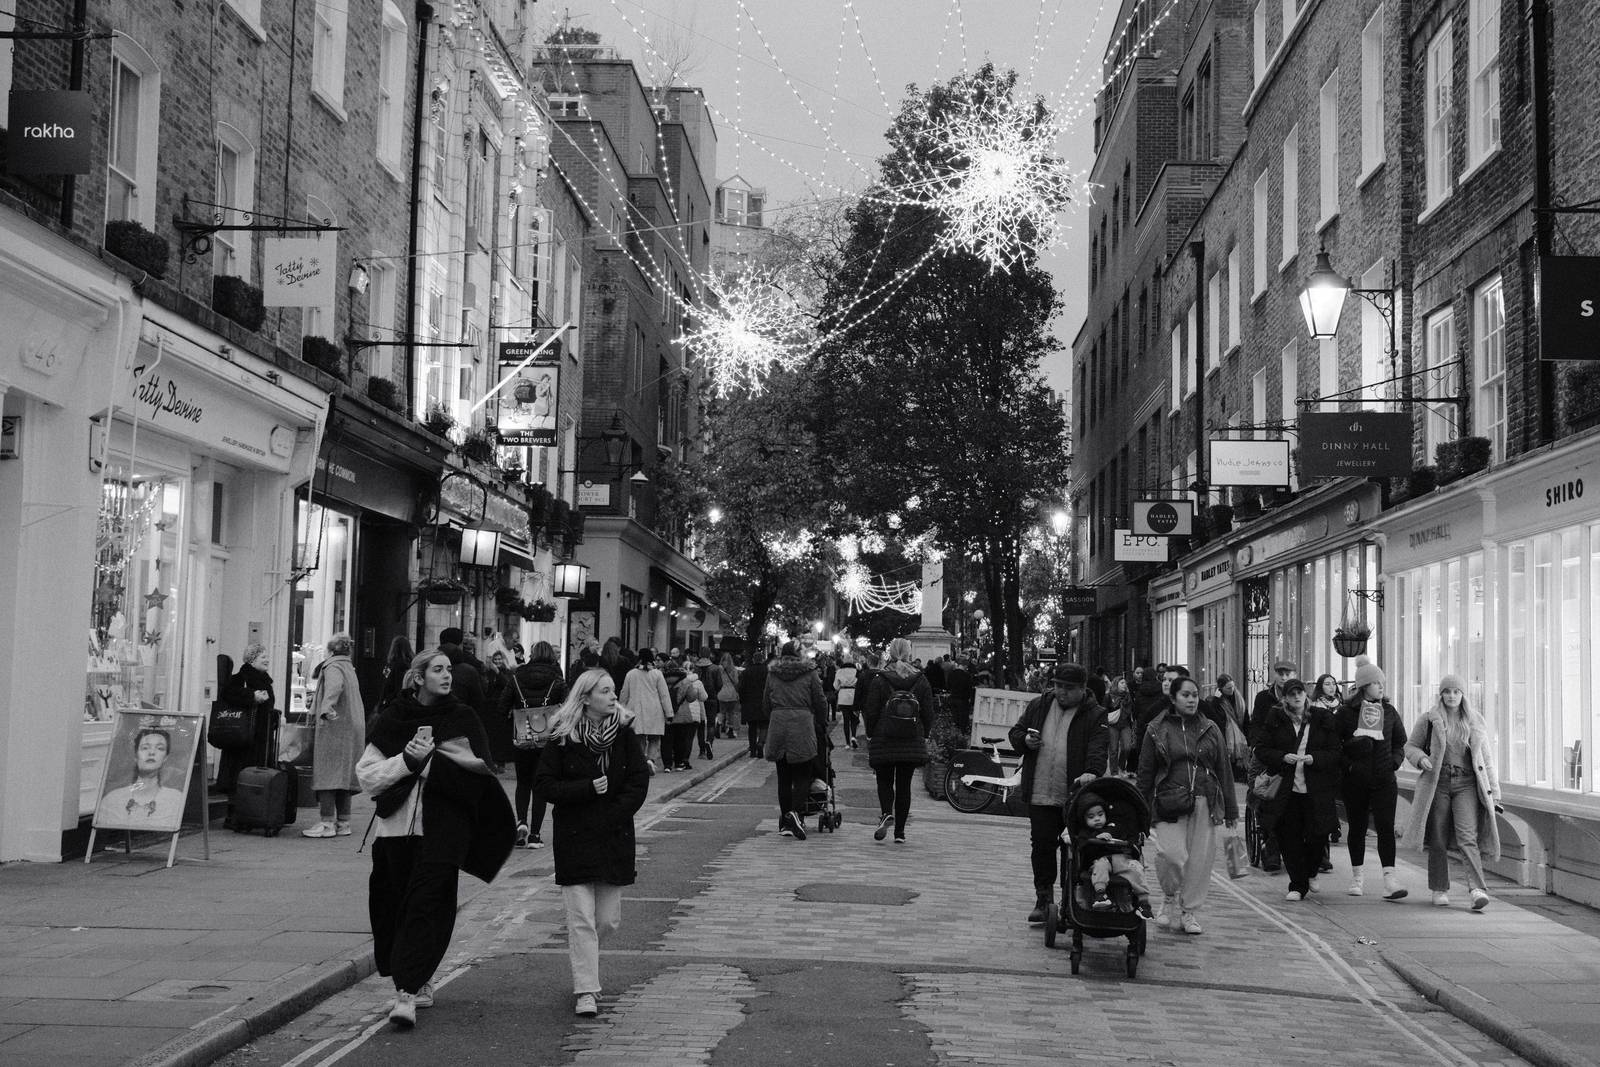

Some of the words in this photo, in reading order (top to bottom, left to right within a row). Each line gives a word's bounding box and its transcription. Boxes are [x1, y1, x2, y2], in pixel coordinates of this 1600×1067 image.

[24, 123, 75, 138] rakha
[275, 260, 304, 277] Tatty
[286, 268, 321, 286] Devine
[162, 380, 203, 423] Devine
[1321, 442, 1359, 450] DINNY
[1362, 442, 1390, 451] HALL
[1546, 478, 1584, 508] SHIRO
